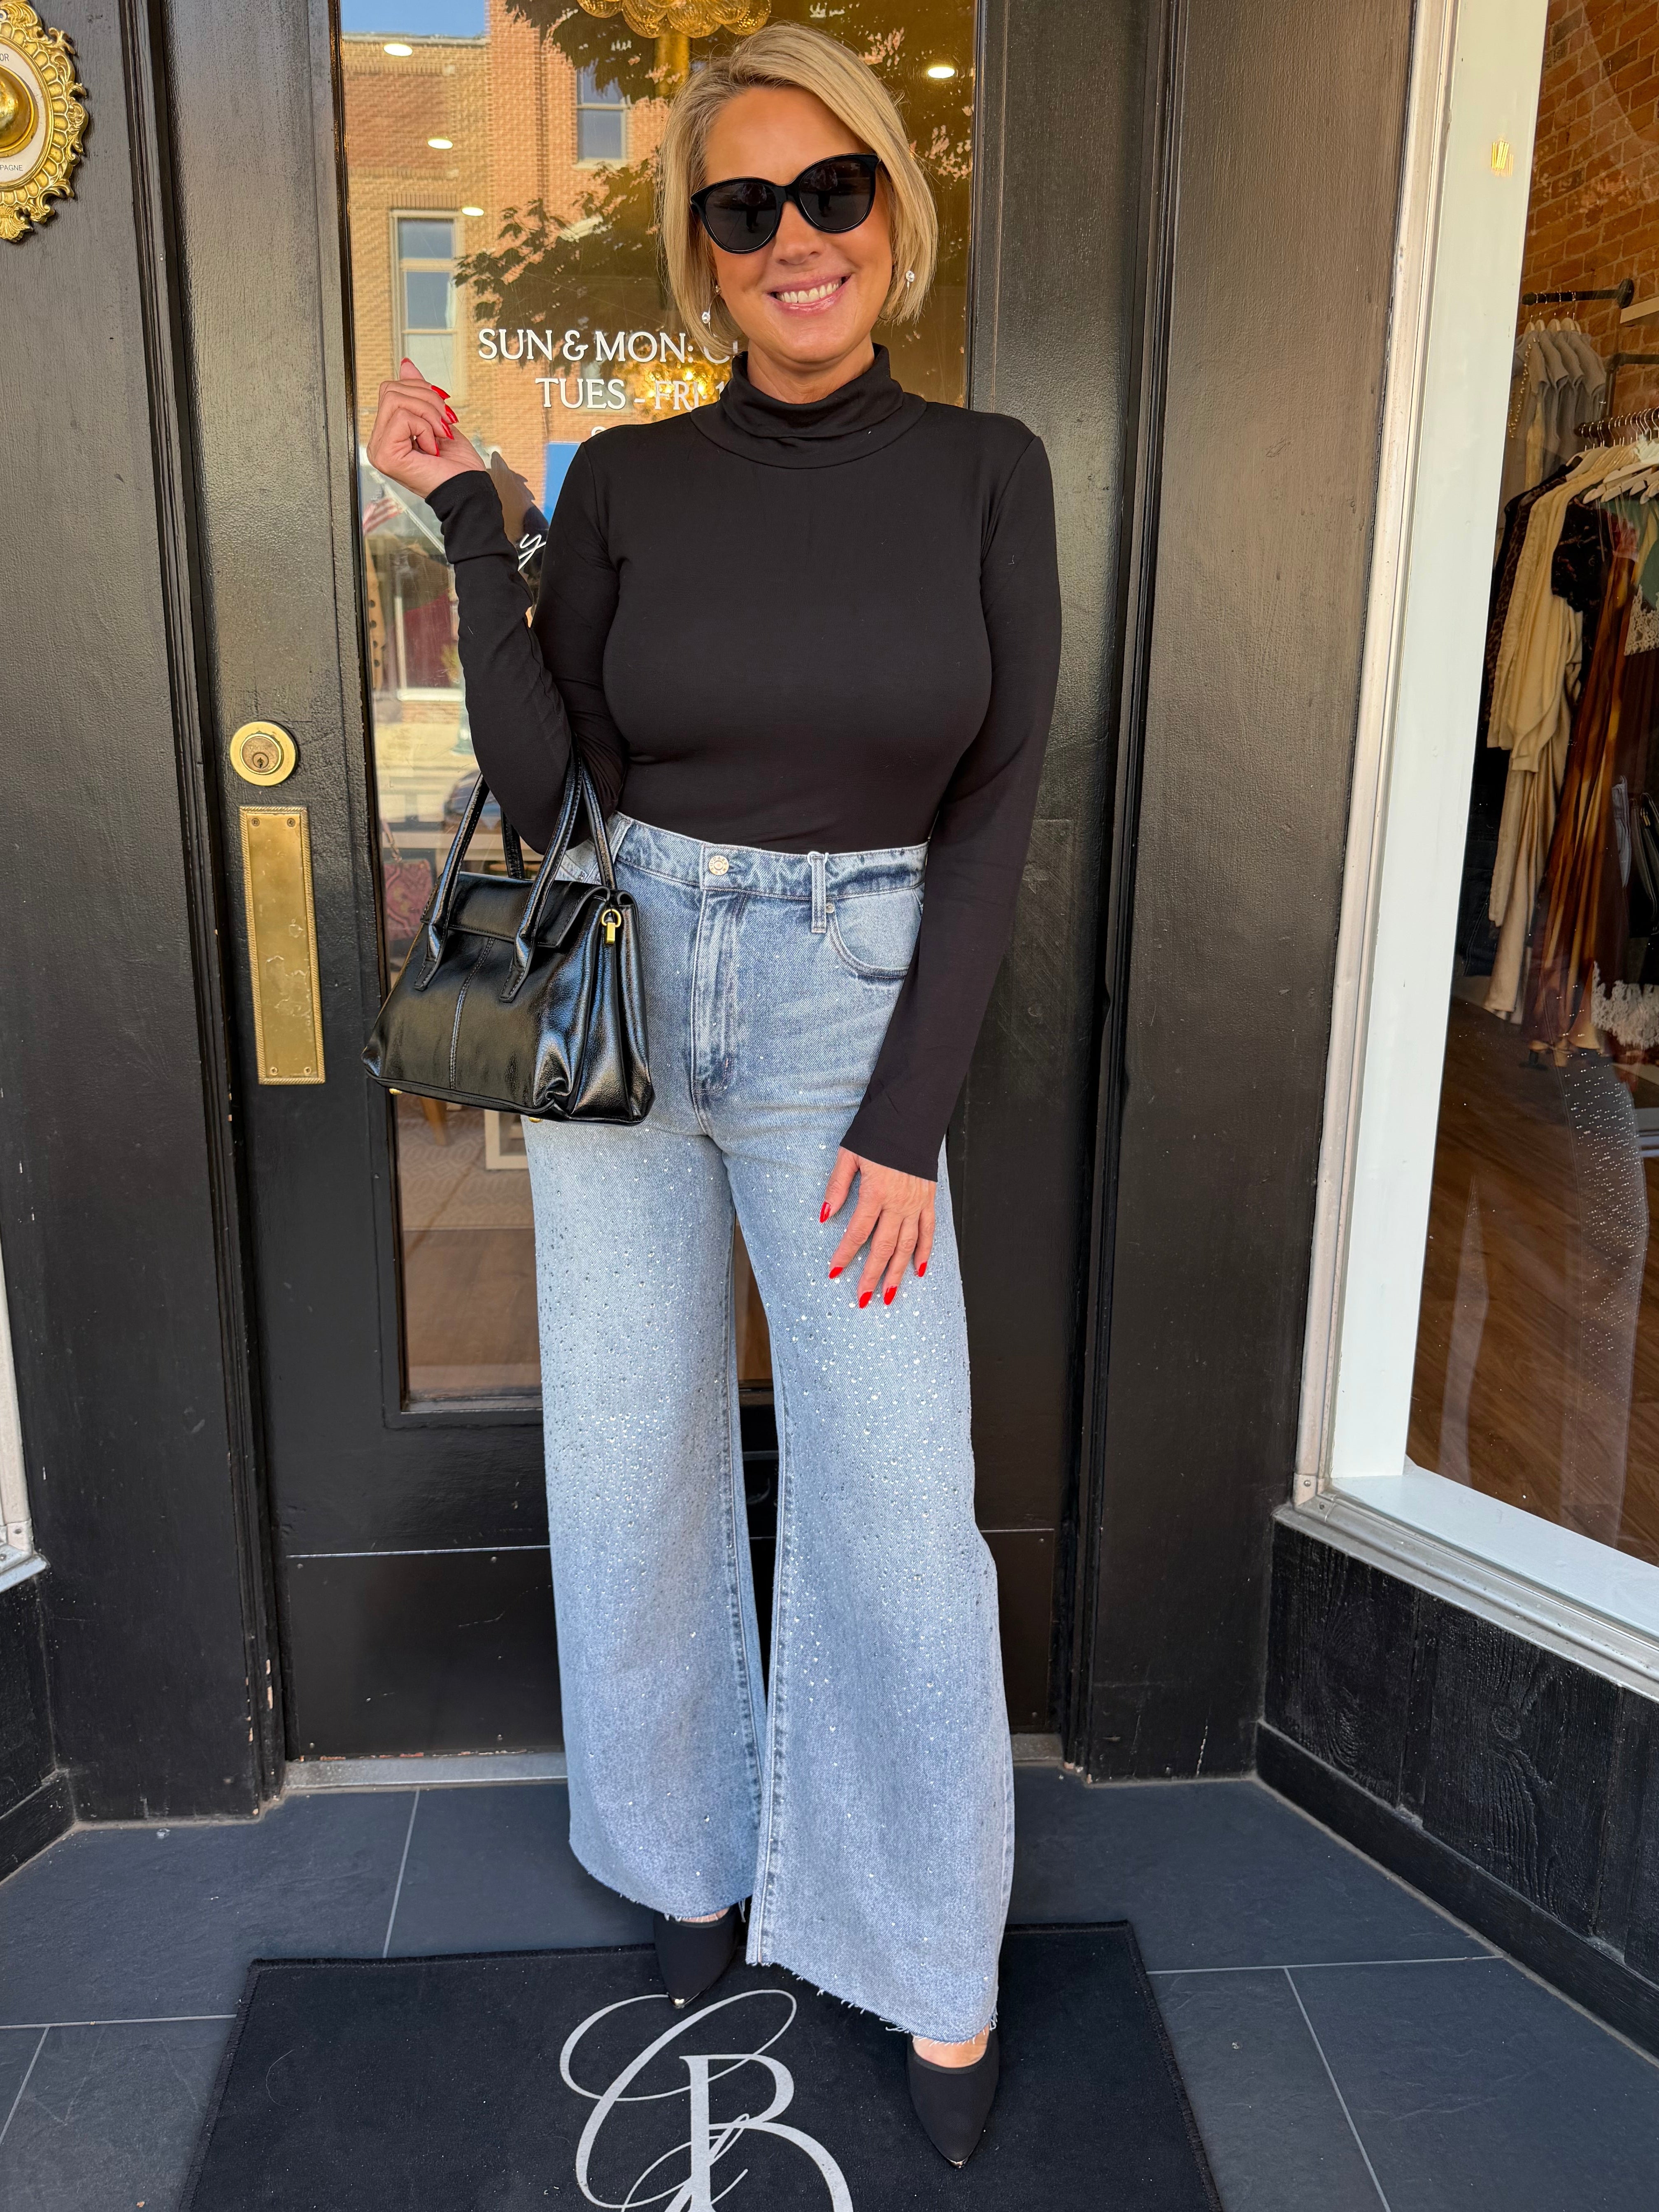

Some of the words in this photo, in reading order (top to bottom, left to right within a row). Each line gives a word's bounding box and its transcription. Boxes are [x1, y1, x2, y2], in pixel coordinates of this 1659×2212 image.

[478, 328, 553, 361] SUN
[563, 330, 589, 361] &
[596, 331, 693, 363] MON:
[535, 378, 626, 409] TUES
